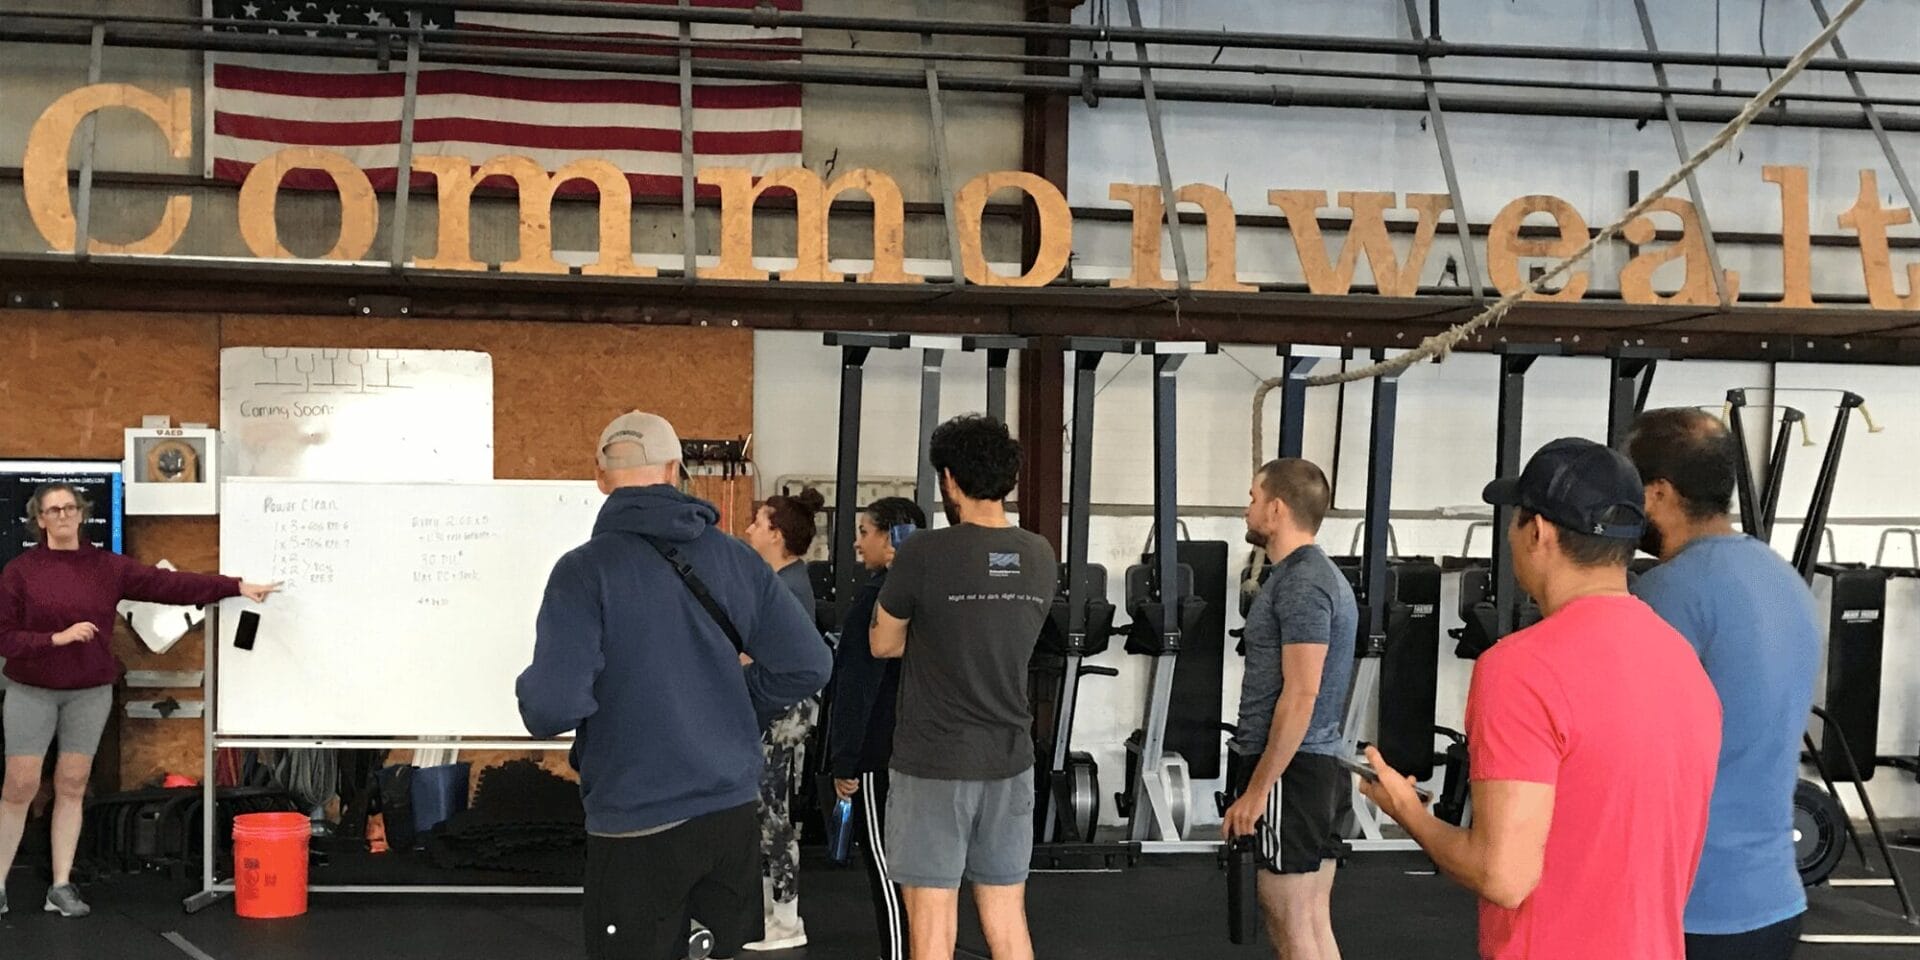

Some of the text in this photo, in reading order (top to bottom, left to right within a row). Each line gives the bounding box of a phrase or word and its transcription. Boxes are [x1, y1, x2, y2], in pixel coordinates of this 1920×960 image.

[240, 400, 290, 419] Coming
[263, 496, 339, 514] Power Clean
